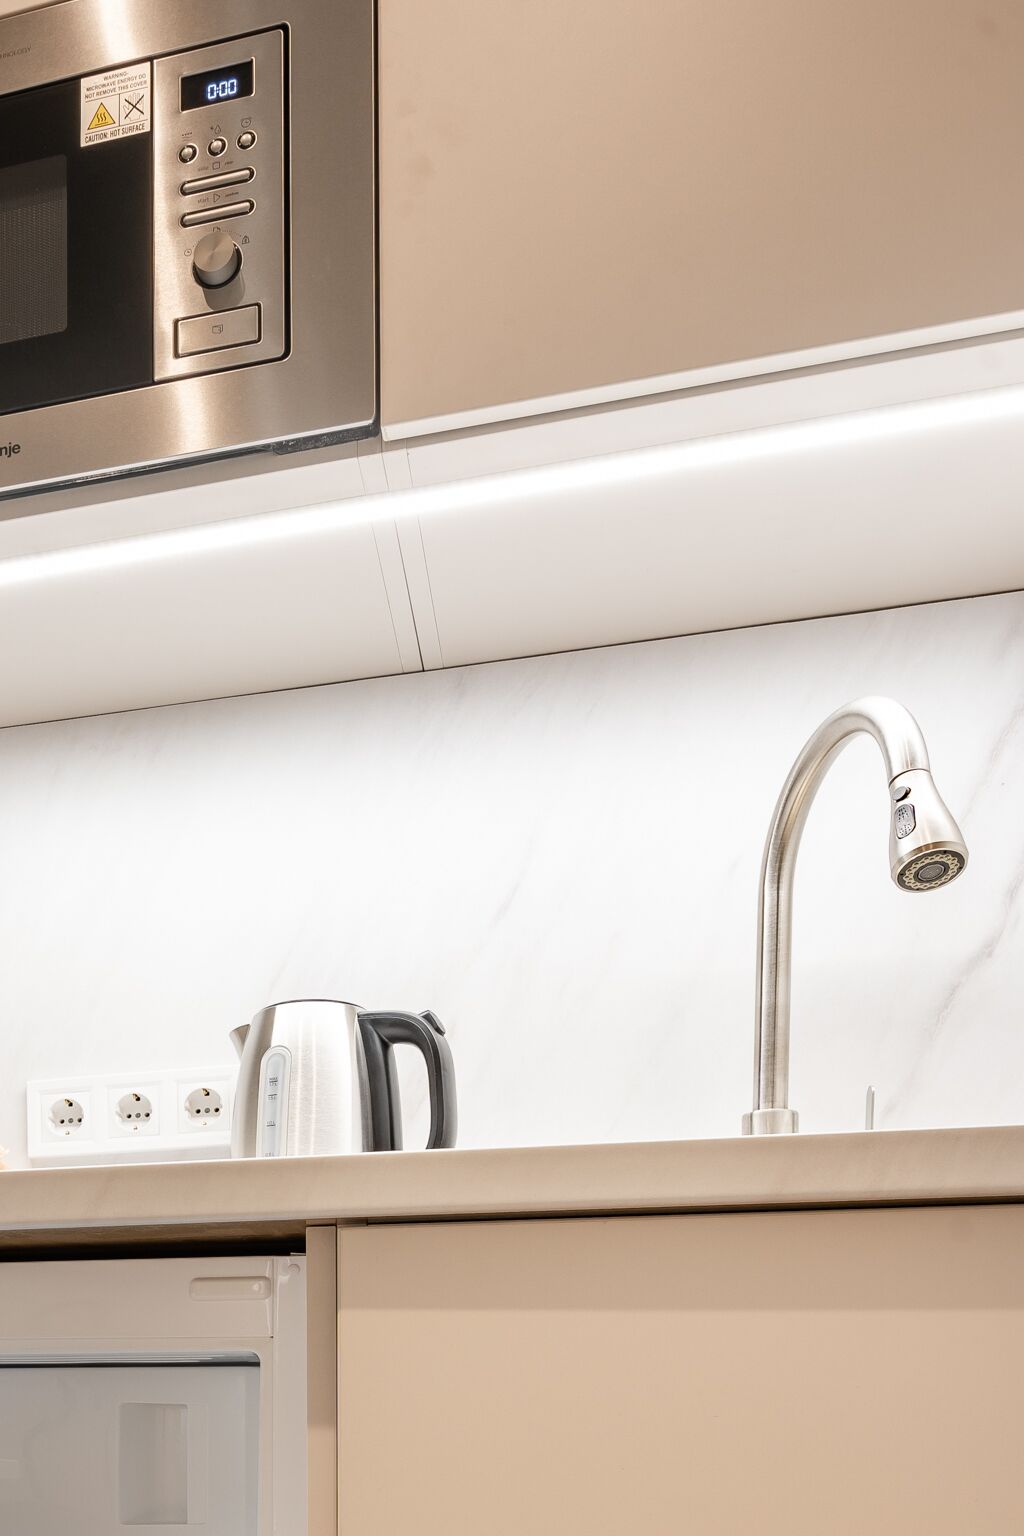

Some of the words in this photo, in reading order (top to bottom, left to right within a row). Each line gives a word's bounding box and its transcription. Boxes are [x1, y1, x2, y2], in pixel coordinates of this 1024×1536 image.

[86, 81, 116, 91] MICROWAVE
[117, 75, 137, 84] ENERGY
[96, 88, 117, 97] REMOVE
[130, 80, 147, 88] COVER
[207, 79, 237, 100] 0:00
[85, 132, 108, 144] CAUTION:
[110, 129, 120, 138] HOT
[121, 123, 145, 134] SURFACE
